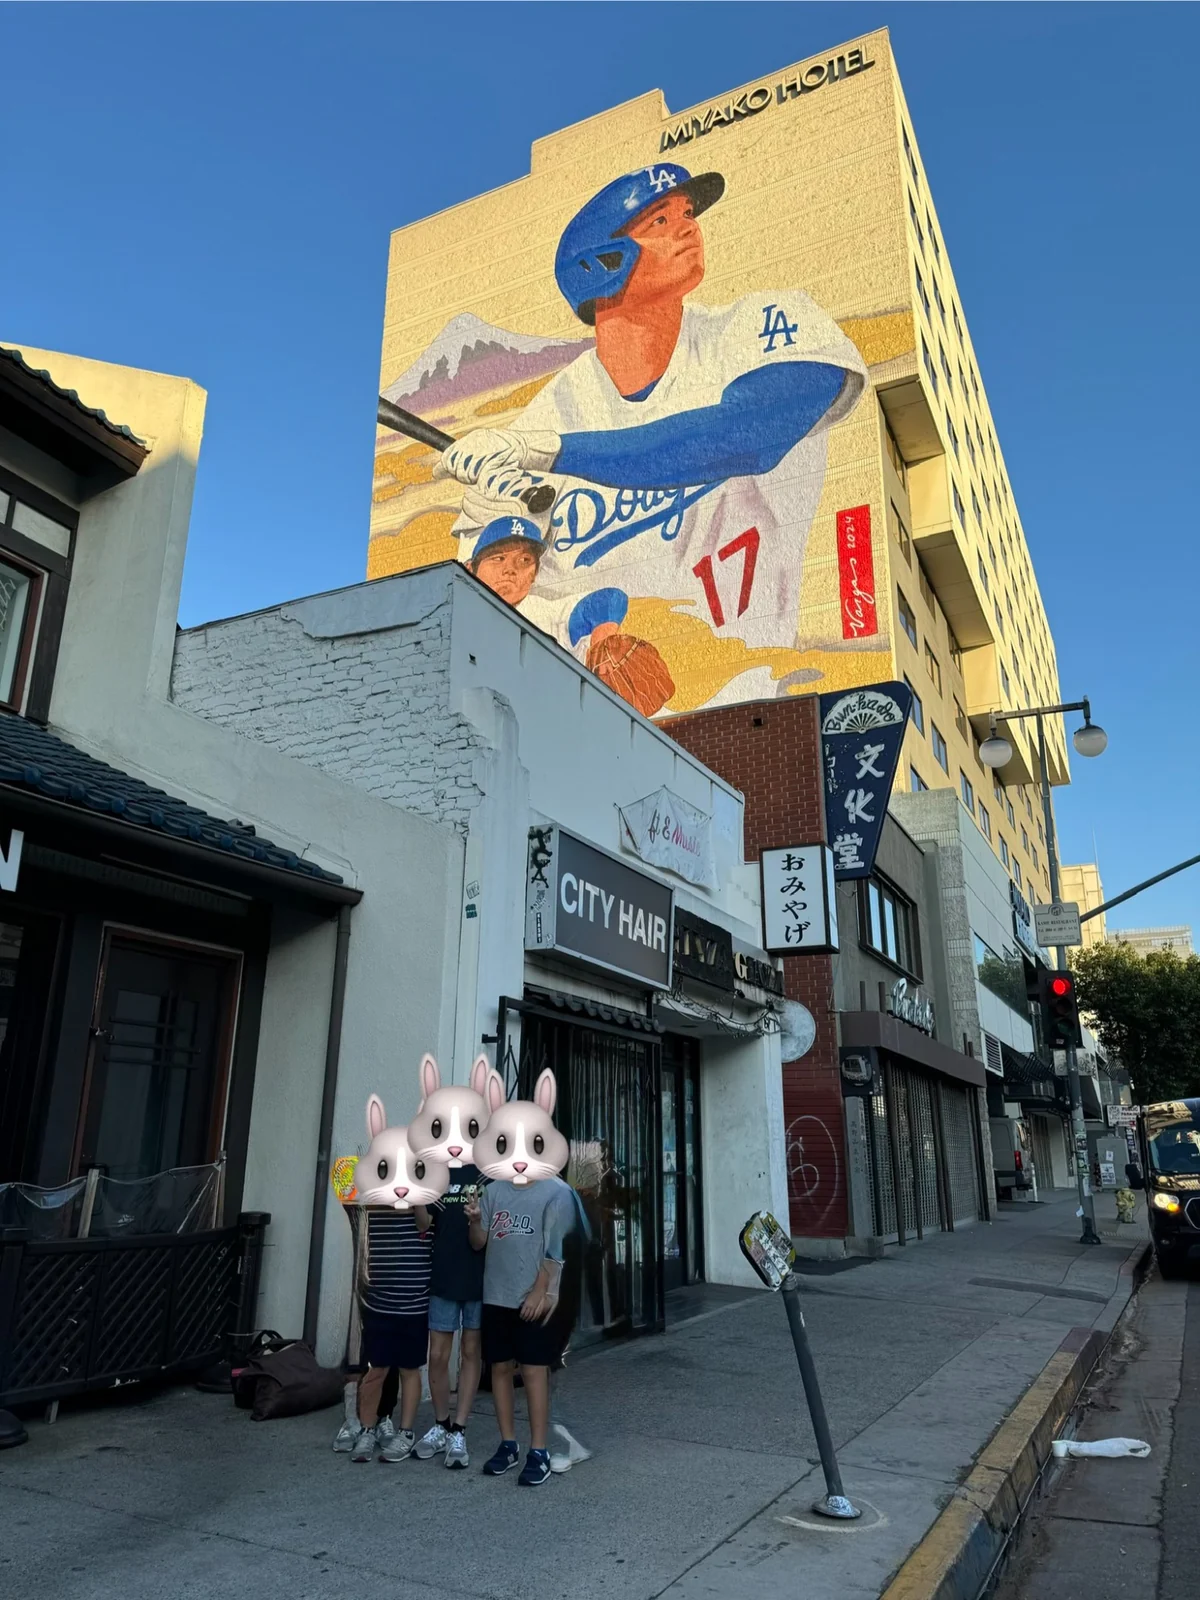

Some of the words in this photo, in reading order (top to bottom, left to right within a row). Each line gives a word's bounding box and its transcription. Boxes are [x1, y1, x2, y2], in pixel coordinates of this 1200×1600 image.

[662, 86, 772, 149] MIYAKO
[780, 44, 875, 98] HOTEL
[645, 166, 677, 193] LA
[758, 304, 798, 353] LA
[511, 519, 525, 536] LA
[845, 516, 856, 549] 2024
[692, 526, 760, 628] 17
[844, 557, 875, 637] Vargas
[833, 743, 885, 870] 文化堂
[560, 872, 615, 929] CITY
[618, 899, 667, 954] HAIR
[779, 853, 811, 945] おみやげ
